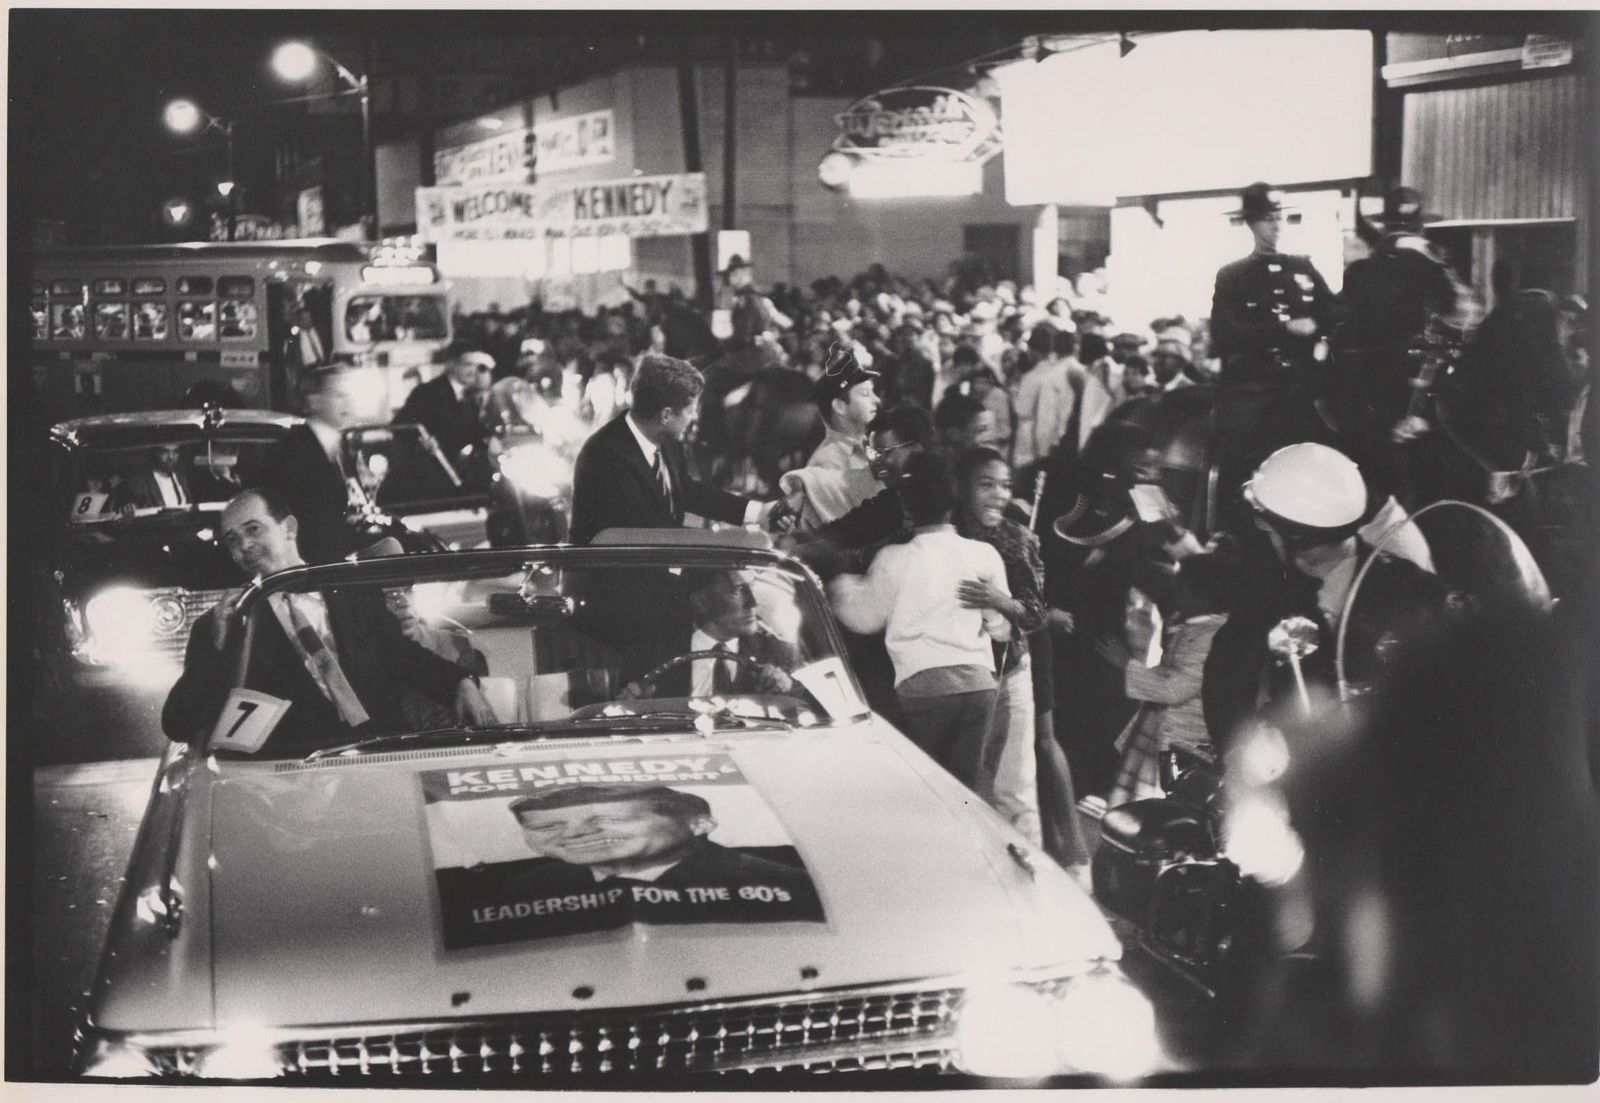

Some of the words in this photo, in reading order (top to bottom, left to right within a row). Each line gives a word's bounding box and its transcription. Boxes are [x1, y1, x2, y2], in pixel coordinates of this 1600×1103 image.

[452, 190, 533, 223] WELCOME
[573, 181, 674, 220] KENNEDY
[77, 496, 92, 514] 8
[226, 701, 259, 738] 7
[447, 757, 711, 787] KENNEDY
[450, 782, 520, 796] FOR
[534, 771, 721, 788] PRESIDENT
[473, 888, 623, 924] LEADERSHIP
[631, 885, 681, 904] FOR
[686, 886, 731, 903] THE
[738, 885, 793, 903] 60's
